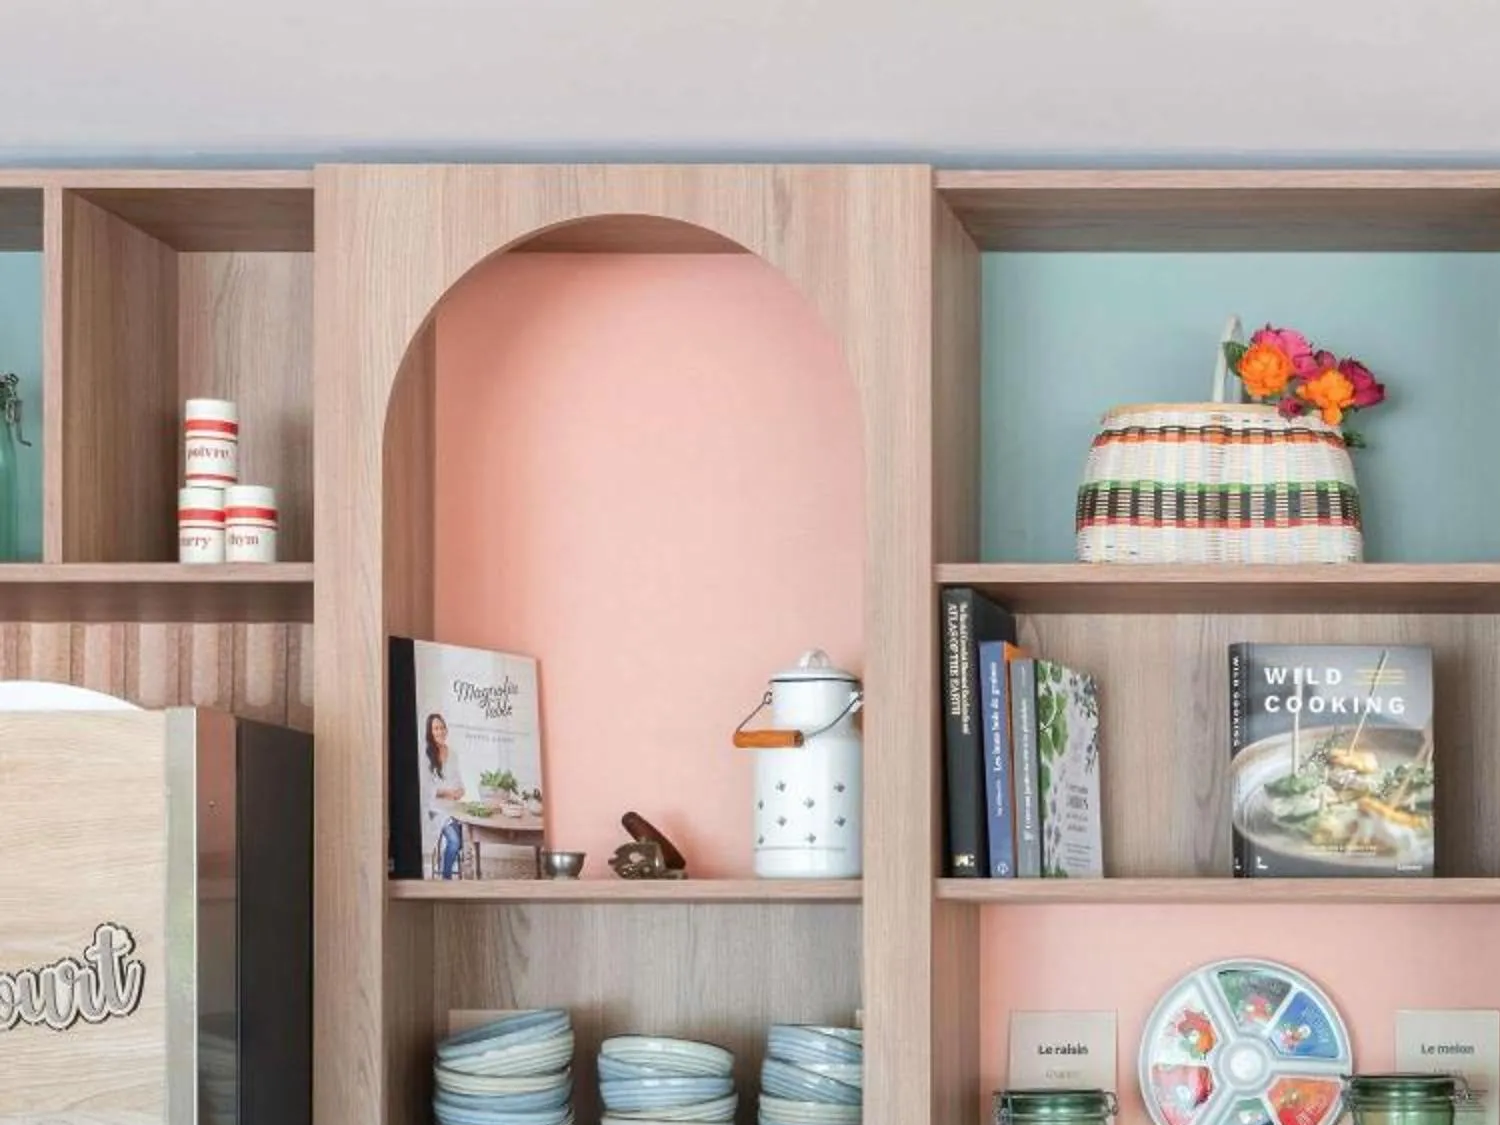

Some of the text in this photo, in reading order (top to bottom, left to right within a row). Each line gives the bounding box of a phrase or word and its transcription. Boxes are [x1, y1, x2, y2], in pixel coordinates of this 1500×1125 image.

[949, 653, 960, 677] THE
[1264, 667, 1342, 685] WILD
[949, 678, 961, 716] EARTH
[1264, 695, 1405, 714] COOKING
[1038, 1042, 1089, 1056] Le raisin
[1421, 1043, 1475, 1055] Le melon
